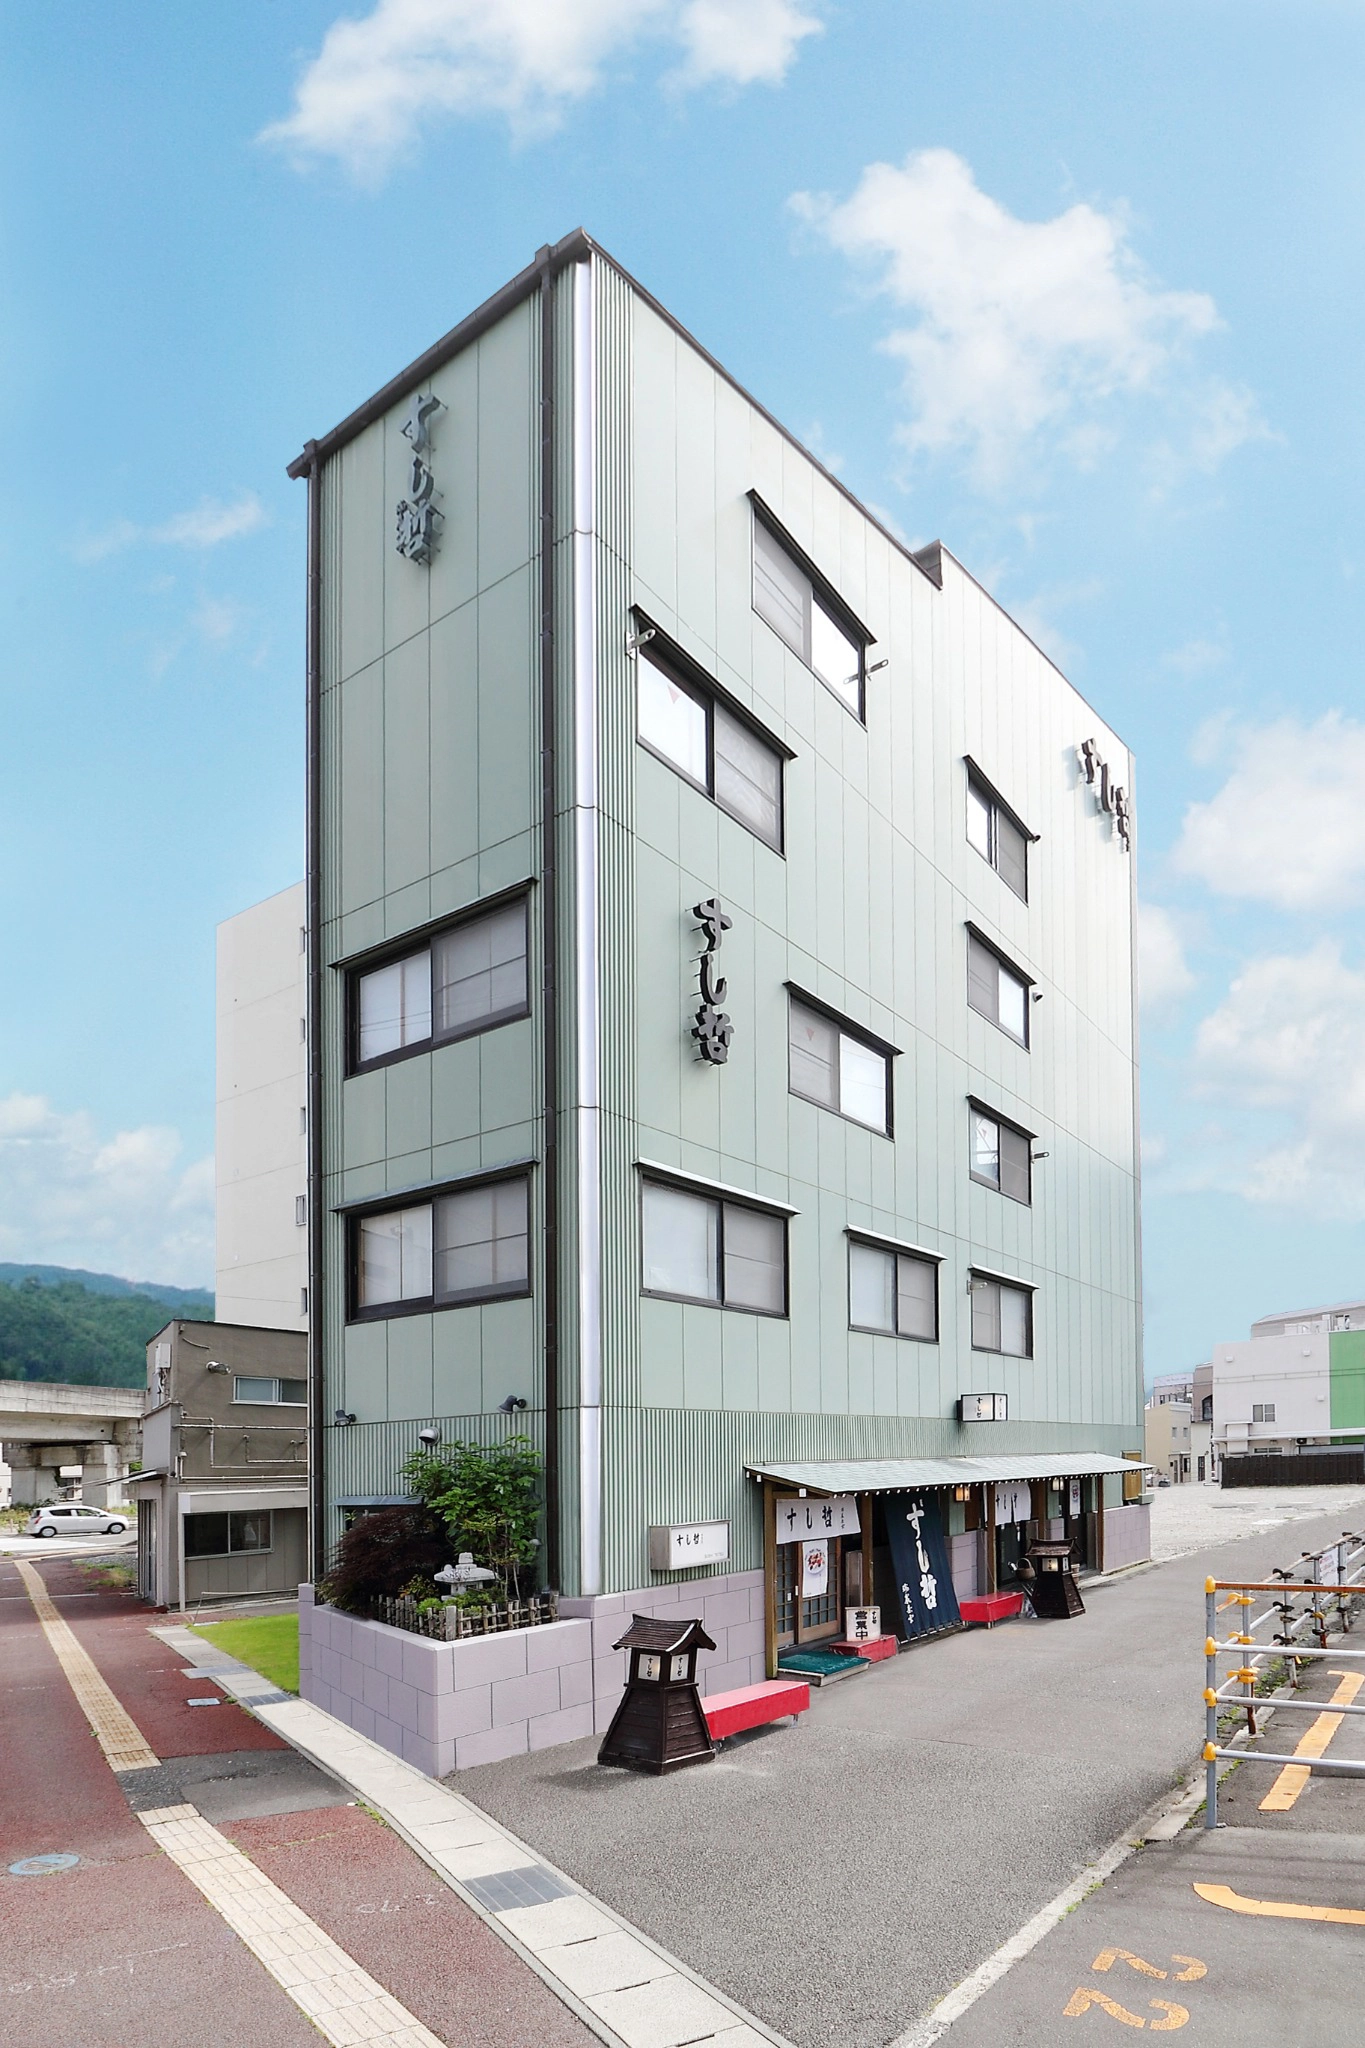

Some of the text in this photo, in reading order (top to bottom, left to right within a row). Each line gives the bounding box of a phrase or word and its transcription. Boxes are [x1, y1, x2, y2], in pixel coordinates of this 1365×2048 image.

[397, 393, 438, 562] すし哲
[694, 897, 735, 1064] すし哲
[676, 1532, 700, 1547] すし哲
[787, 1505, 833, 1532] すし哲
[906, 1504, 937, 1610] すし哲
[855, 1610, 868, 1640] 営業中
